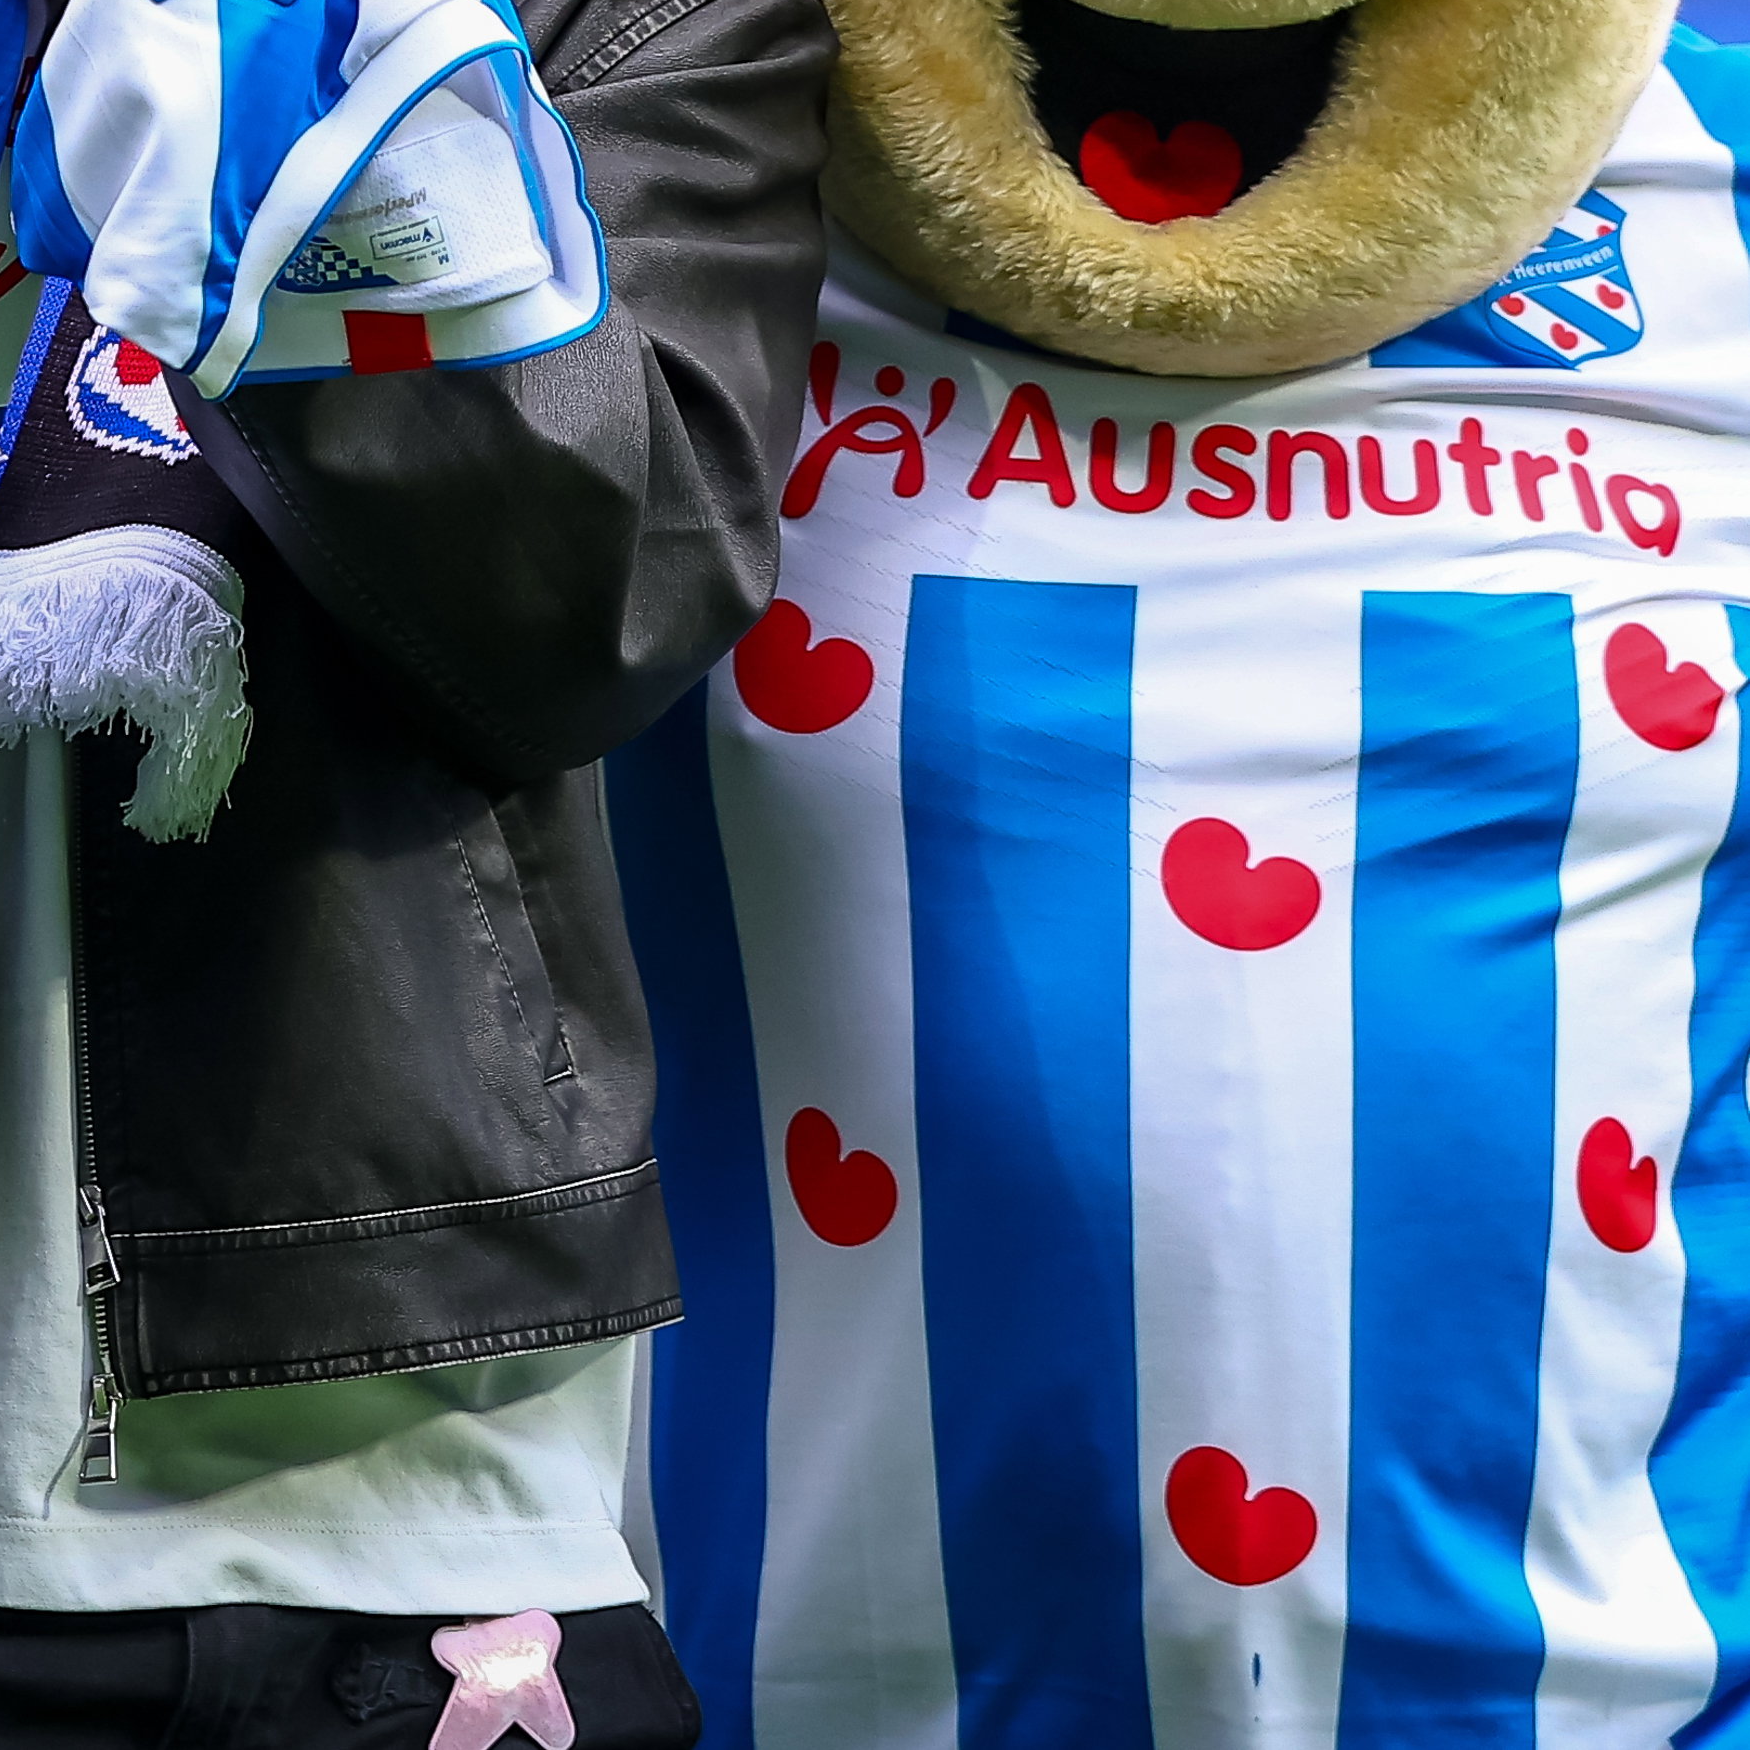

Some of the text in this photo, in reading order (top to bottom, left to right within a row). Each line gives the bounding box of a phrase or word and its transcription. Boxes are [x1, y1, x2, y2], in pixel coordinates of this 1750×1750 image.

[380, 233, 421, 251] macron
[1512, 244, 1615, 278] Heerenveen
[966, 381, 1681, 558] Ausnutria
